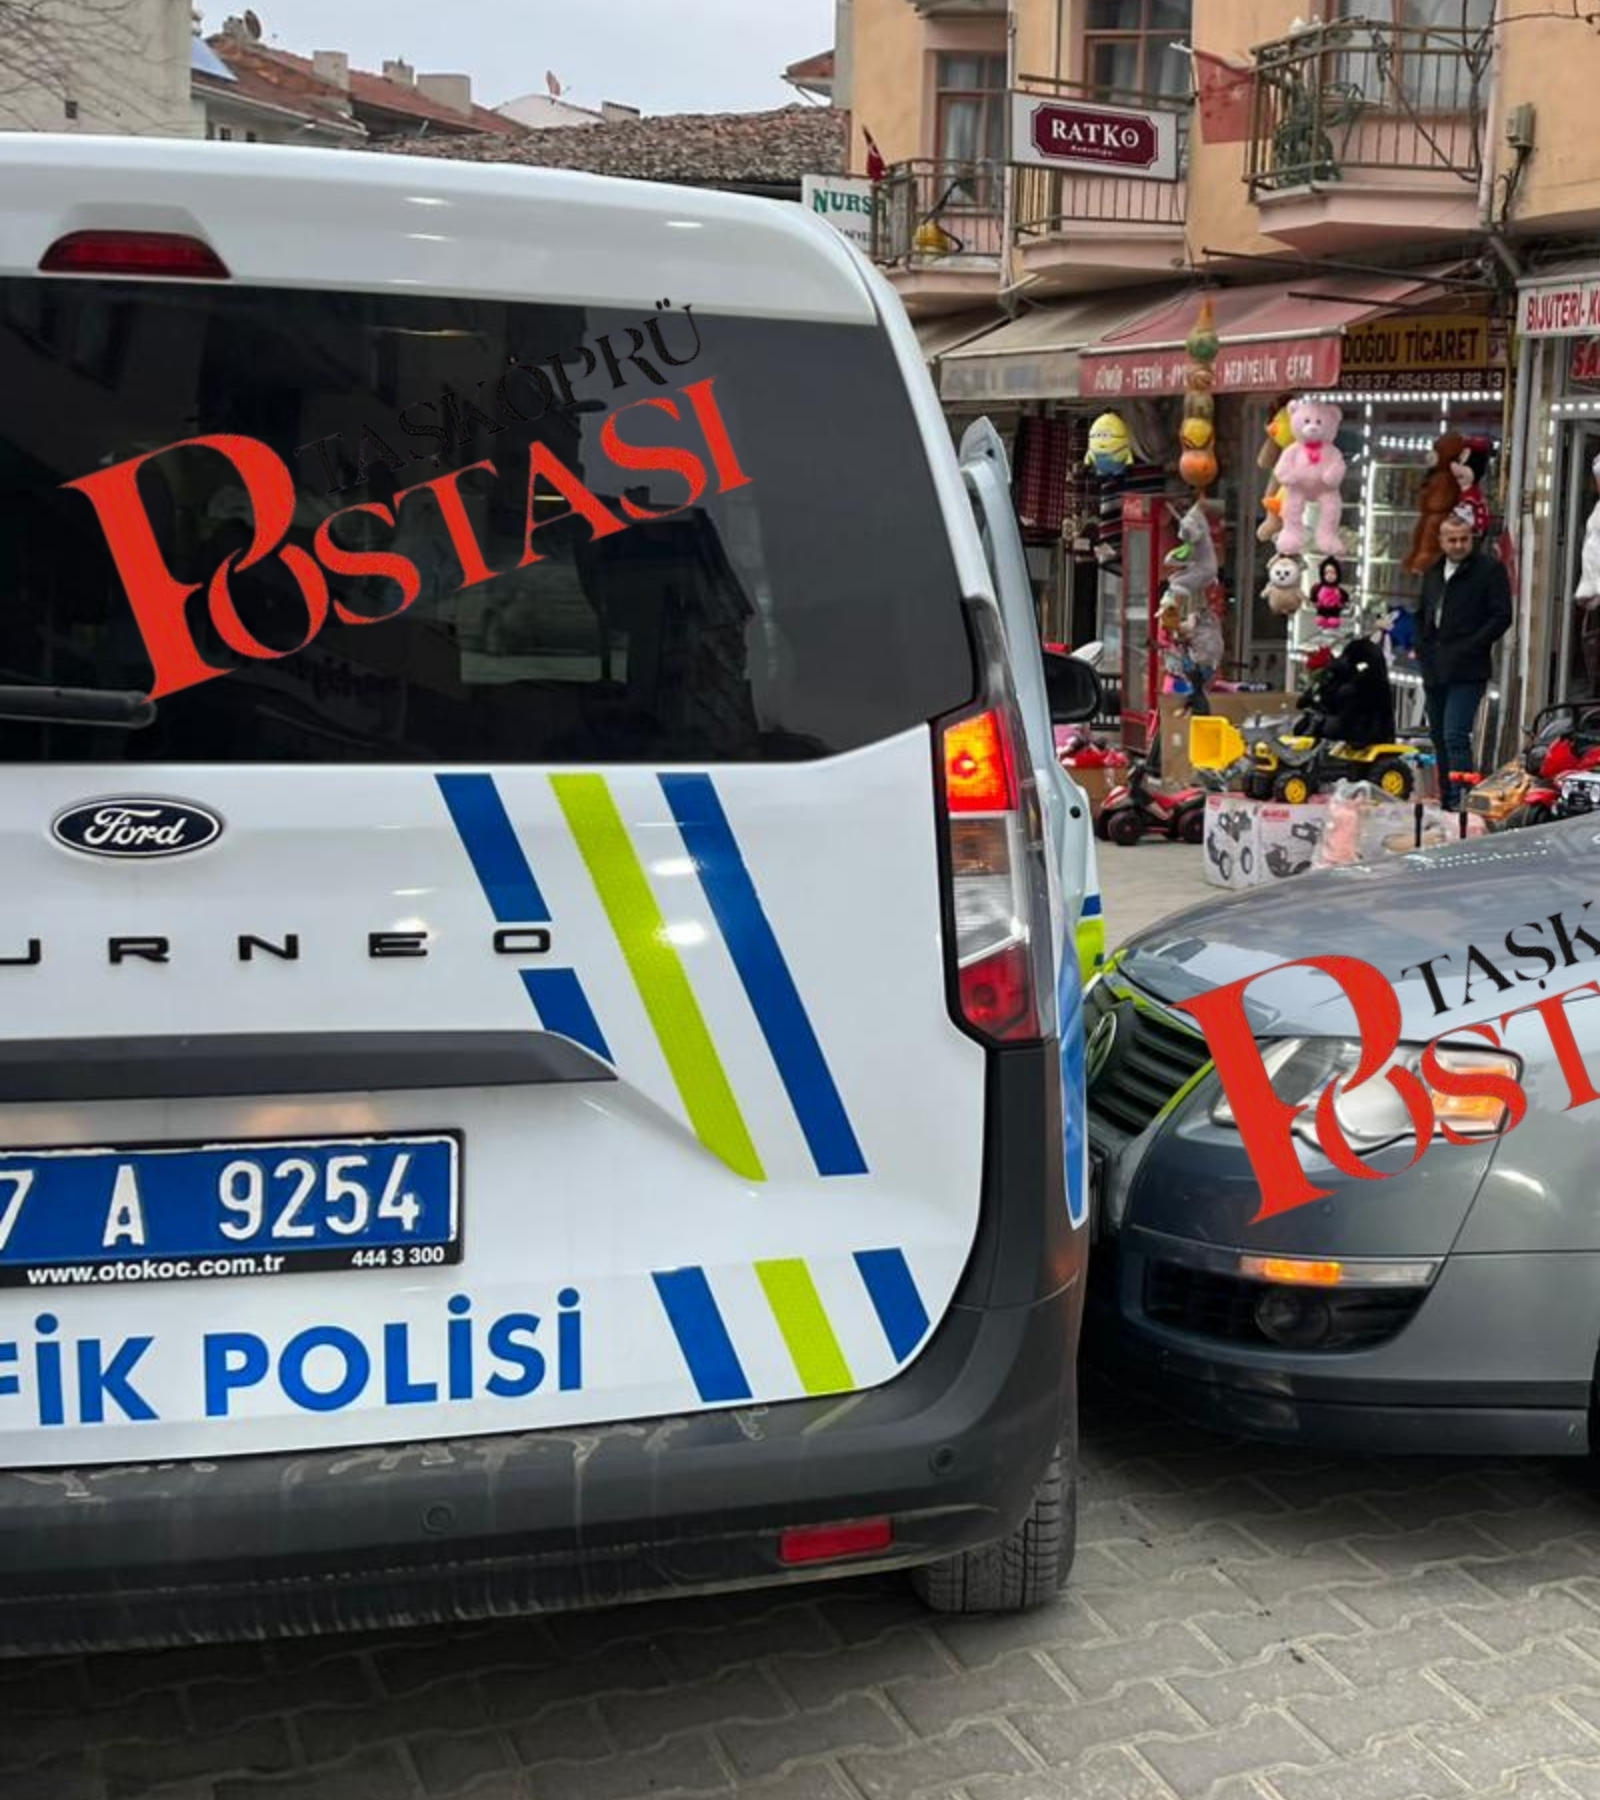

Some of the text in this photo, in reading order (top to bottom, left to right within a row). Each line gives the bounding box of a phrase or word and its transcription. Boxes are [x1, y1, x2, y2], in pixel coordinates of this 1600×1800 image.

[1051, 118, 1140, 148] RATKO
[1405, 324, 1479, 363] TİCARET
[83, 806, 188, 846] Ford
[102, 1163, 146, 1248] A
[218, 1152, 420, 1242] 9254
[27, 1245, 445, 1286] www.otokoc.com.tr 444 3 300
[203, 1286, 584, 1418] POLİSİ
